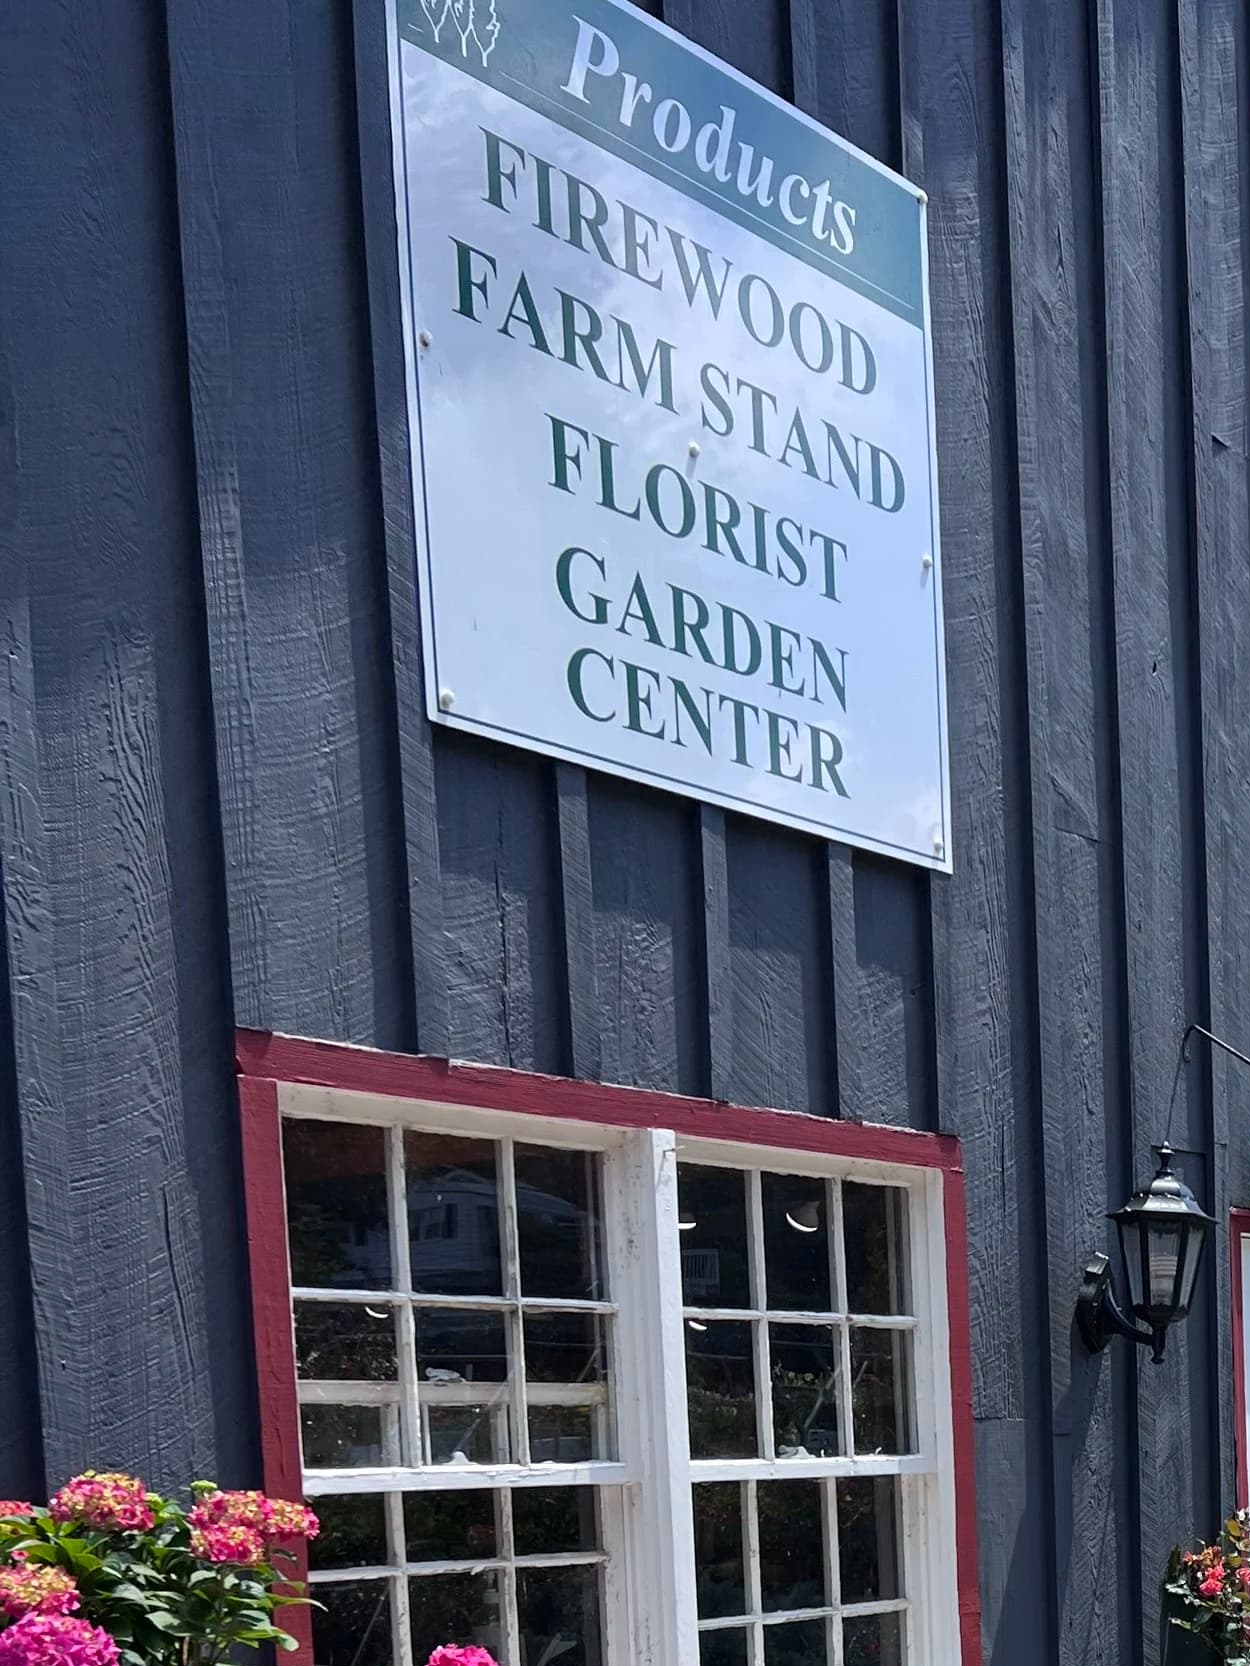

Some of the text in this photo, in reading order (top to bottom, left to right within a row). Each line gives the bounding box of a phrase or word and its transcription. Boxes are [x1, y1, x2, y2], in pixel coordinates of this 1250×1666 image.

[560, 14, 856, 257] Products
[478, 126, 877, 396] FIREWOOD
[450, 236, 906, 515] FARM STAND
[545, 413, 848, 603] FLORIST
[556, 546, 848, 713] GARDEN
[566, 647, 851, 799] CENTER
